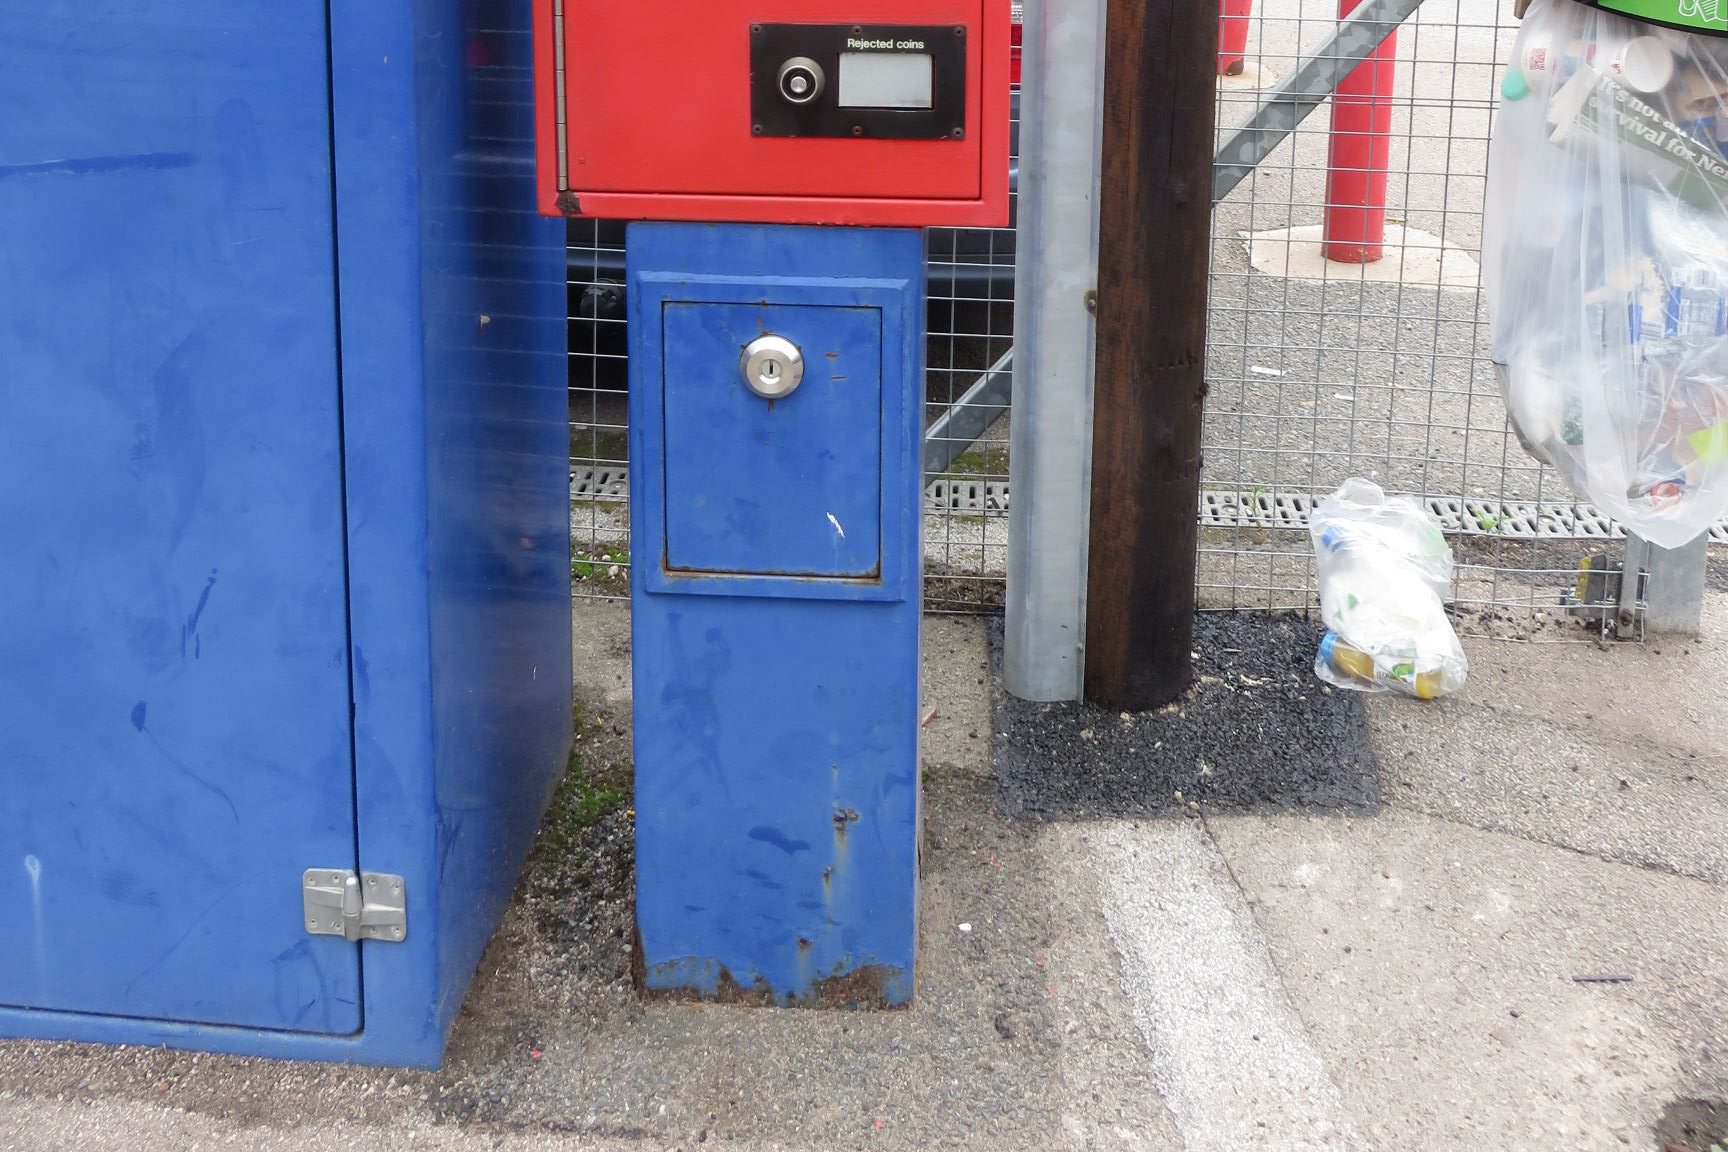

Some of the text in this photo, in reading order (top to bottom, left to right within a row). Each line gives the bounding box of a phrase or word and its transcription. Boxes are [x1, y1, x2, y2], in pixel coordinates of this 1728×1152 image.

[847, 39, 924, 50] Rejected coins
[1588, 96, 1667, 147] svival
[1665, 135, 1696, 161] for
